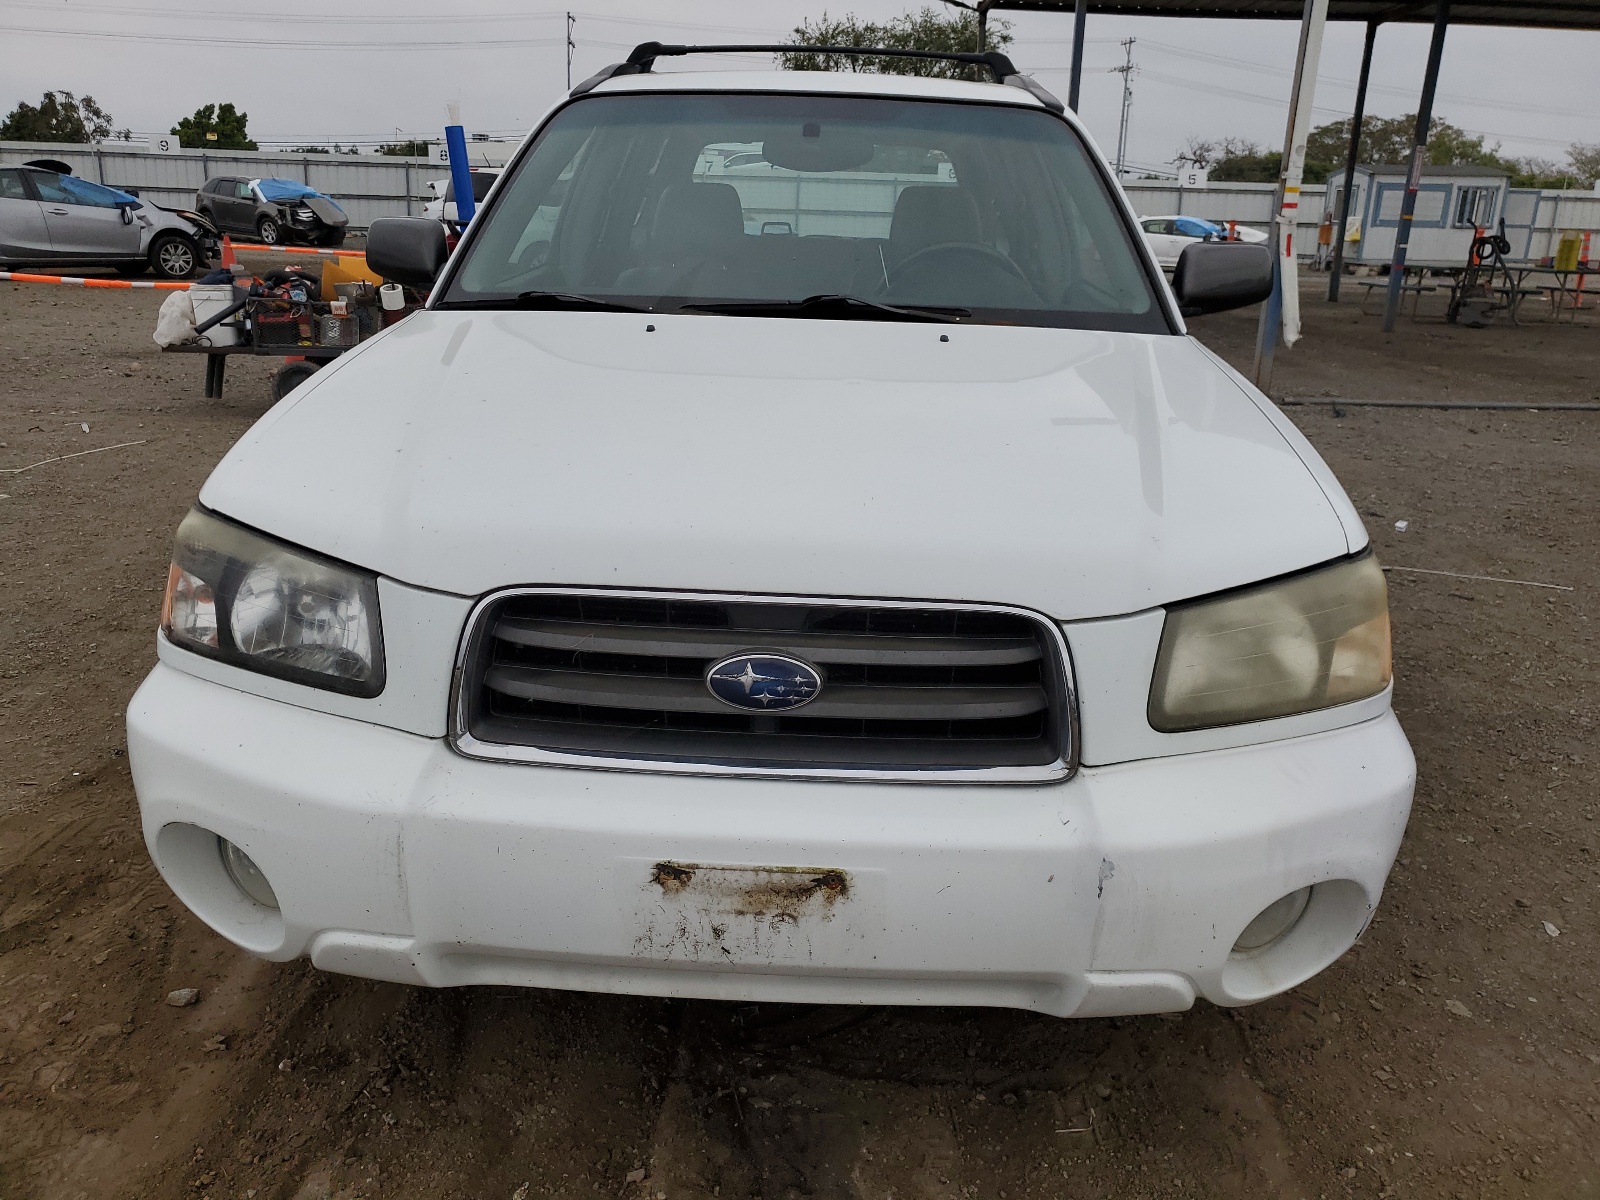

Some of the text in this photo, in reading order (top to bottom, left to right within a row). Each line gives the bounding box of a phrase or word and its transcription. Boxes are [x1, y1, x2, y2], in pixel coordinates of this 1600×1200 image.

[159, 140, 169, 152] 9
[705, 160, 714, 173] 7
[1188, 174, 1197, 185] 5
